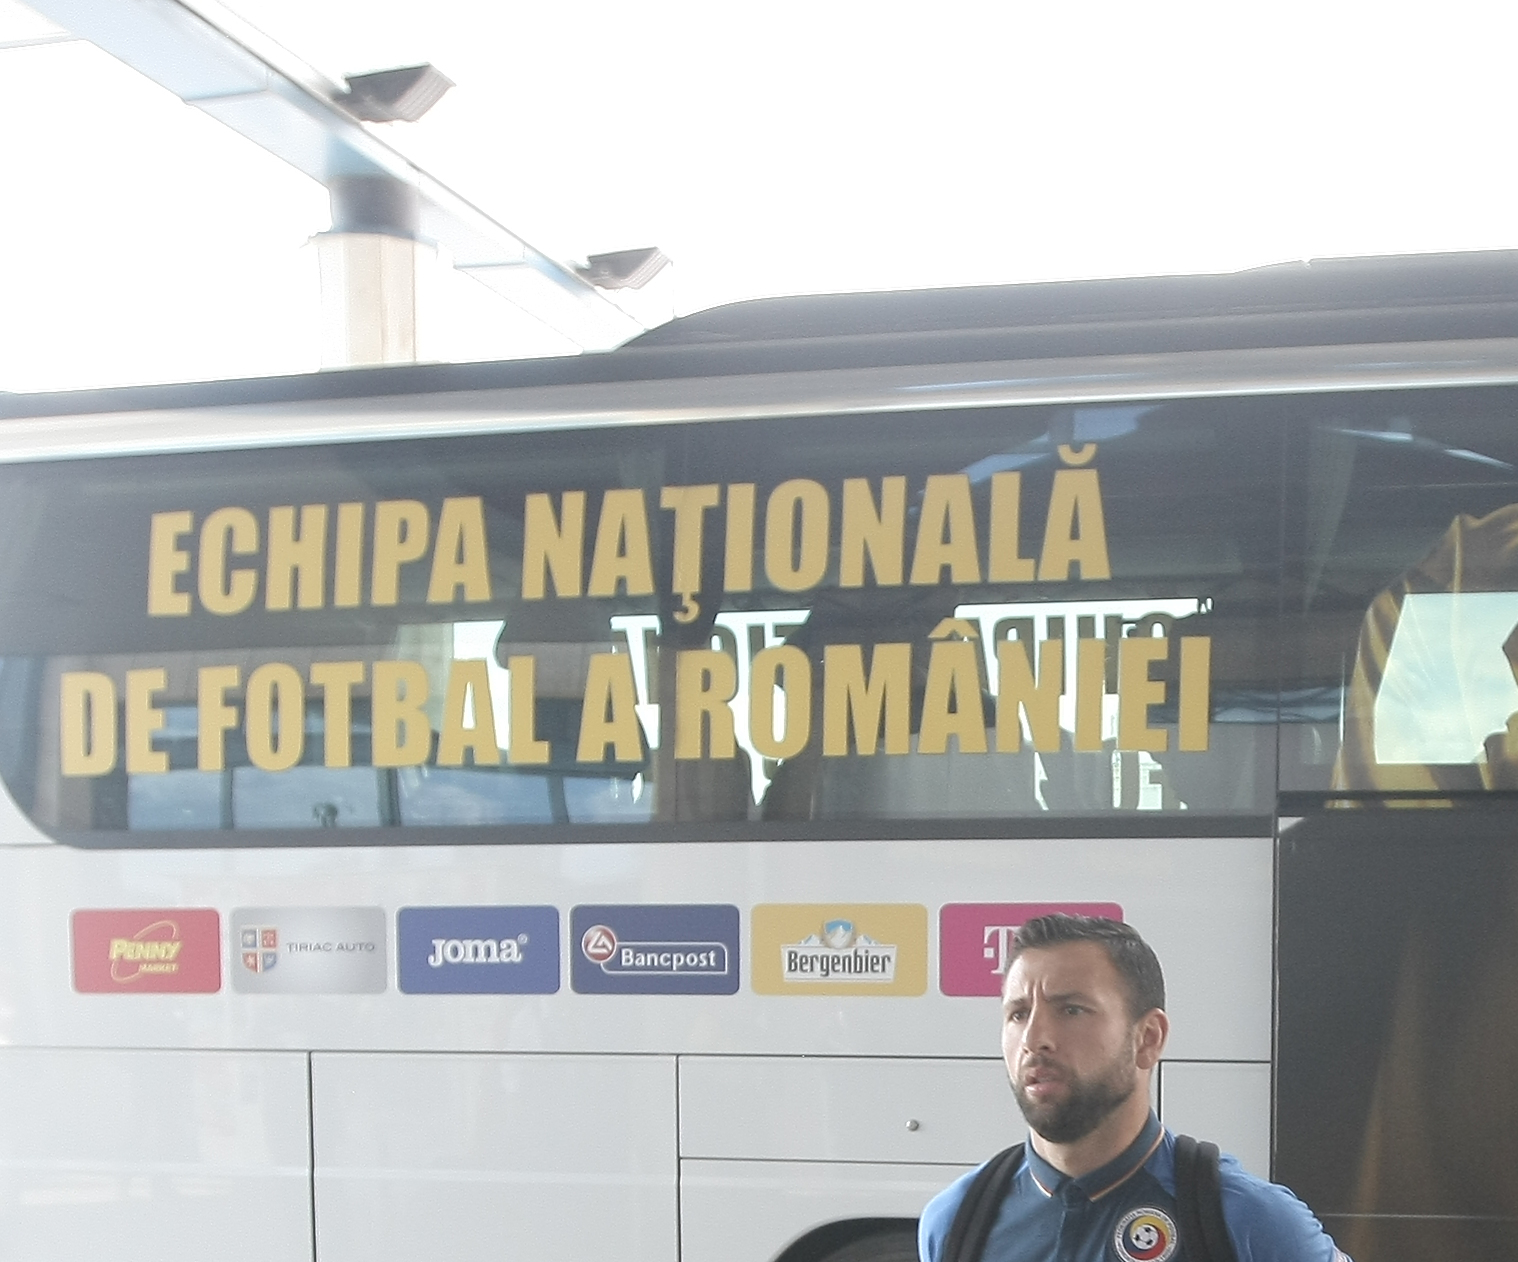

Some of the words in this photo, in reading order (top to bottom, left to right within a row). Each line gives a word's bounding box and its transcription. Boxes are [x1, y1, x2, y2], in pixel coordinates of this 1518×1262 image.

[148, 497, 492, 617] ECHIPA
[60, 667, 171, 777] DE
[197, 654, 550, 774] FOTBAL
[576, 651, 643, 764] A
[674, 616, 1211, 760] ROMÂNIEI
[109, 939, 182, 960] PENNY
[286, 943, 332, 952] TIRIAC
[336, 942, 376, 952] AUTO
[621, 948, 716, 971] Bancpost
[788, 948, 892, 977] Bergenbier
